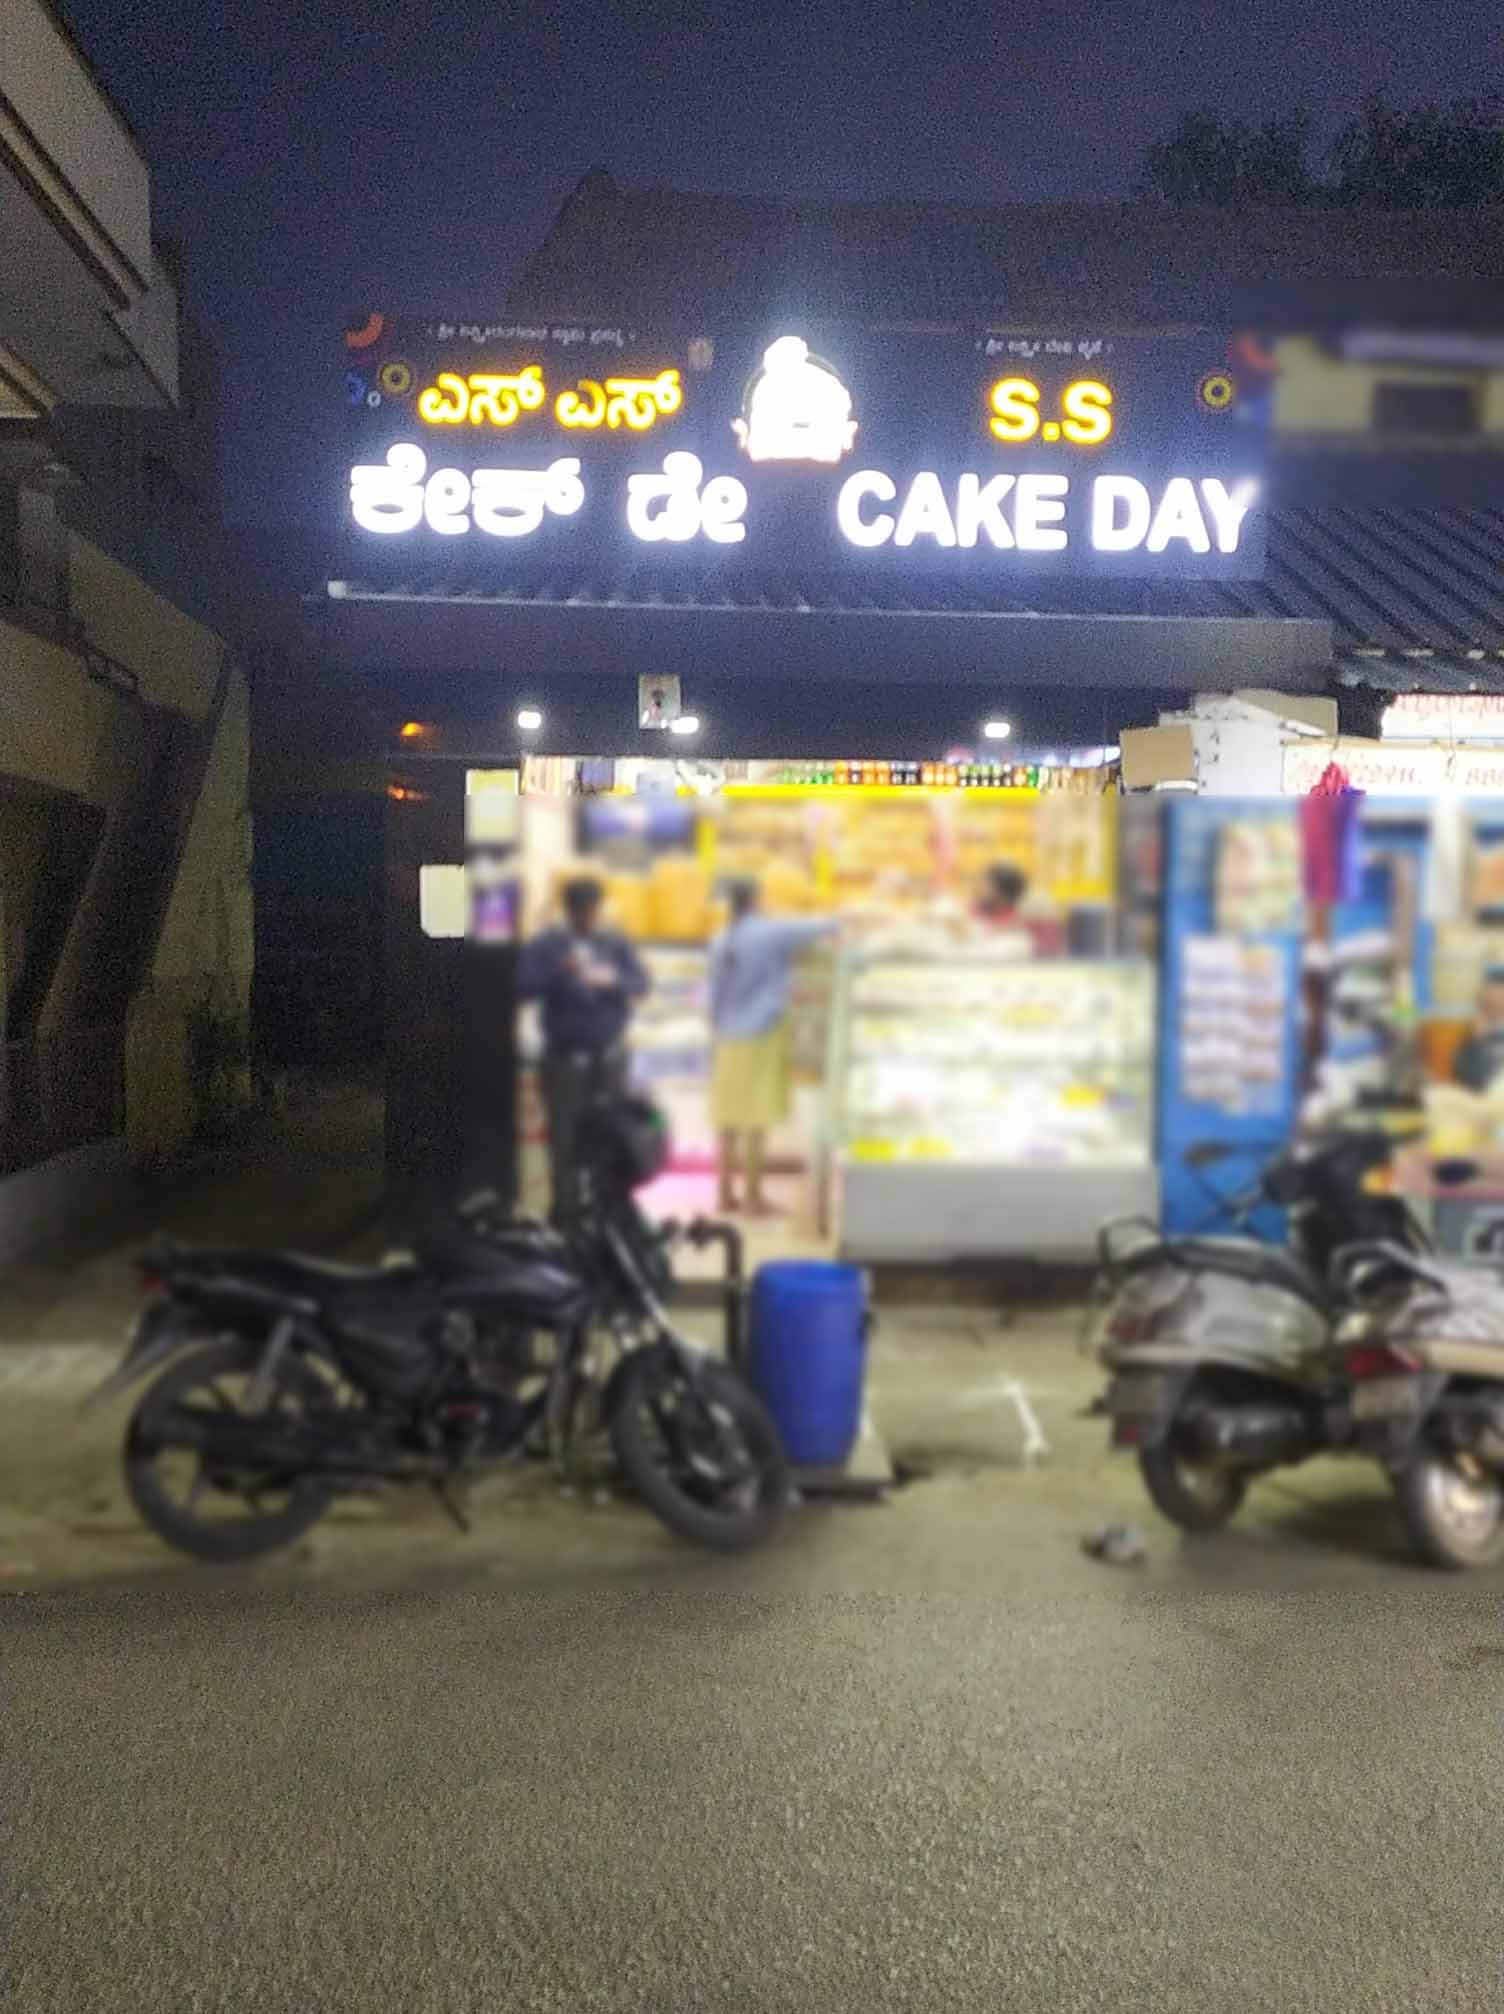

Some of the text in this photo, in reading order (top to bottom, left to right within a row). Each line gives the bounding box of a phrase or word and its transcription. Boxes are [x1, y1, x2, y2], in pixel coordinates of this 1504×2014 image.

[418, 366, 682, 431] ಎಸ್ ಎಸ್
[988, 377, 1112, 445] S.S
[350, 443, 748, 543] ಕೇಕ್ ಡೇ
[837, 470, 1260, 553] CAKE DAY
